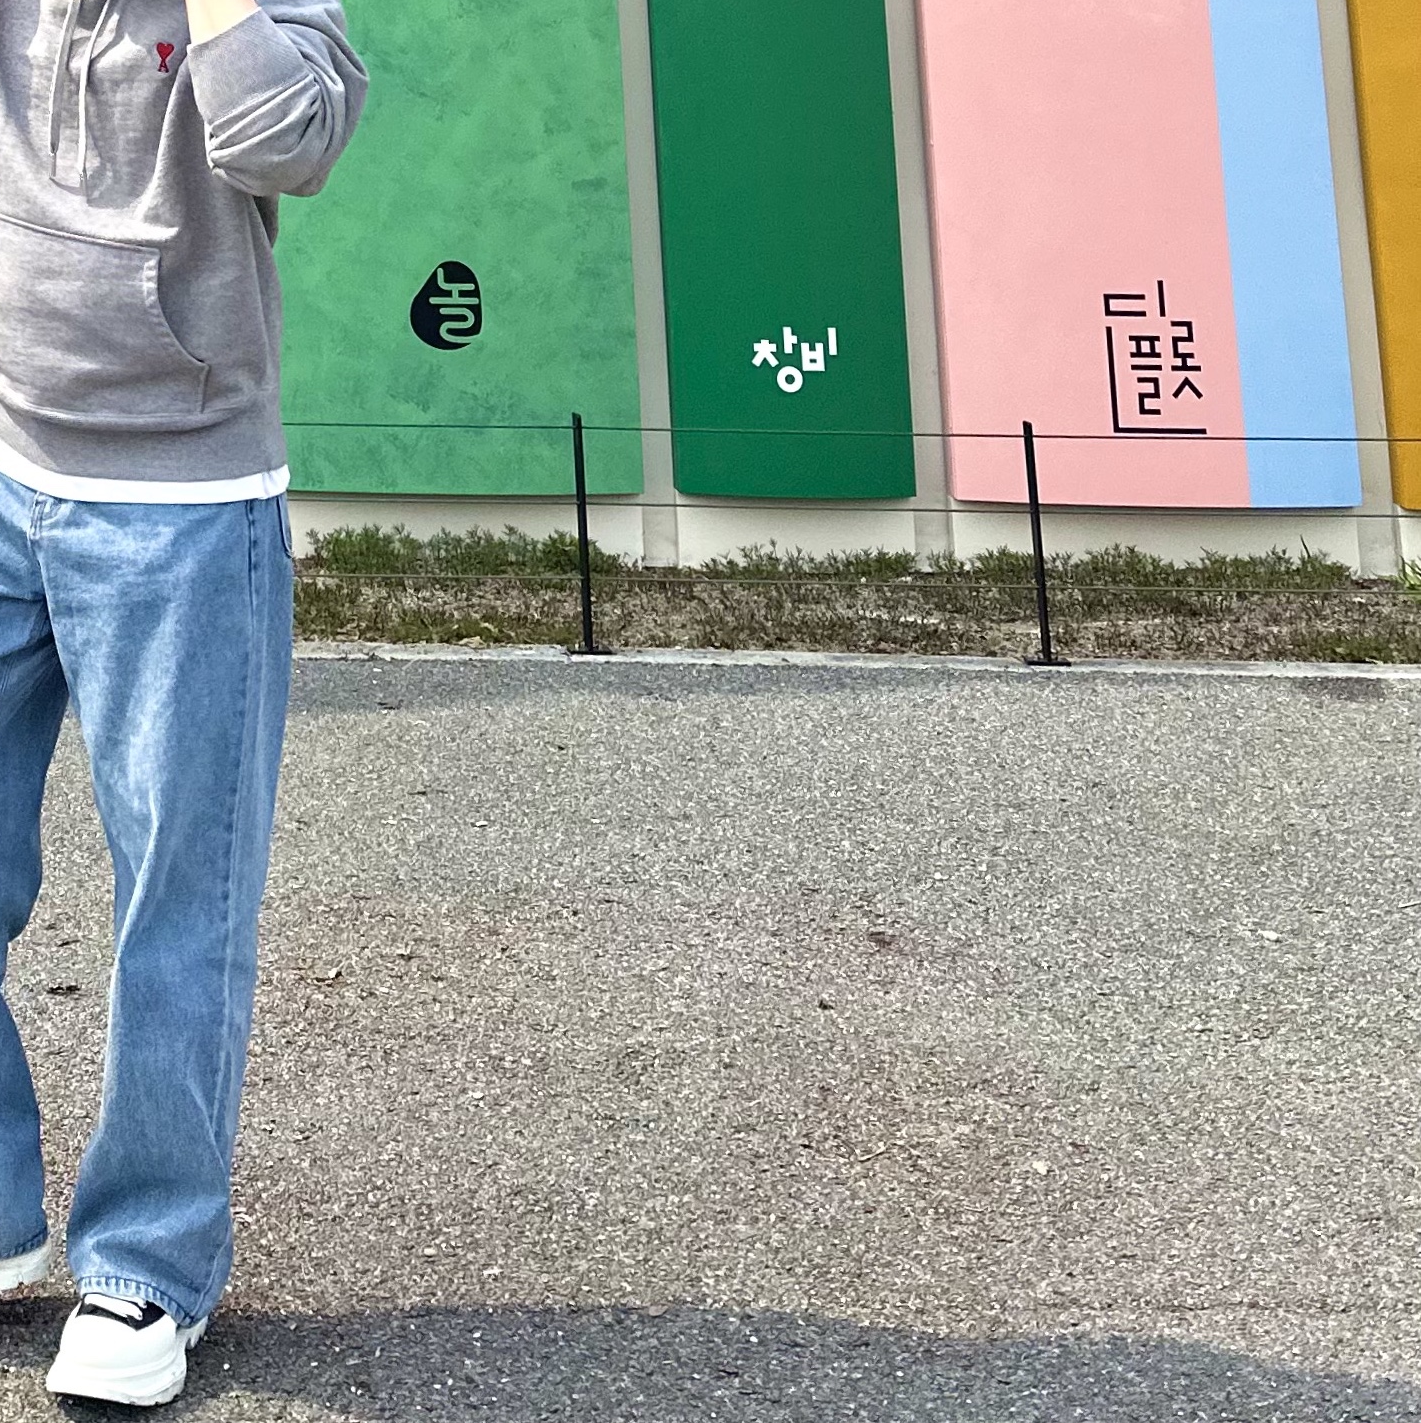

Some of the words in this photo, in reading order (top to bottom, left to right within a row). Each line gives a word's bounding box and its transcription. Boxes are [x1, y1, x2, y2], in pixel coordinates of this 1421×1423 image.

[428, 266, 480, 345] 놀
[752, 327, 837, 392] 창비
[1103, 280, 1204, 415] 디플롯
